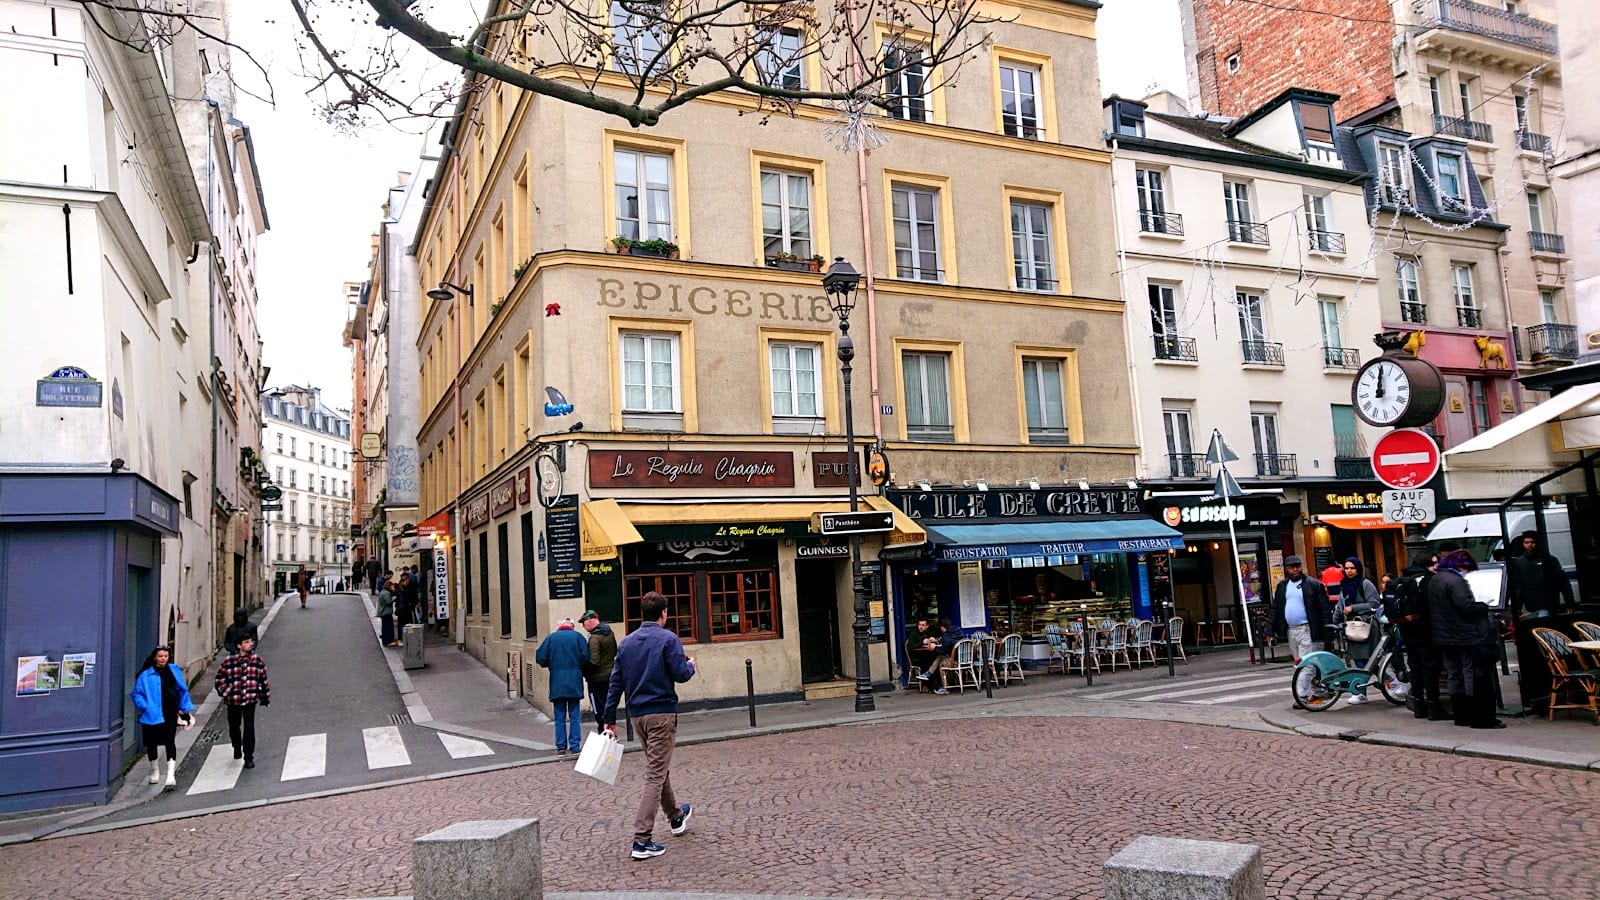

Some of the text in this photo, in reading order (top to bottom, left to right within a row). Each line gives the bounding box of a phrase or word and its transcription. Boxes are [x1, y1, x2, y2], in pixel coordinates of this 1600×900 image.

[596, 278, 834, 323] EPICERIE
[882, 406, 892, 415] 10
[612, 454, 776, 483] Le Requin Chagrin
[817, 462, 859, 476] PUB
[1391, 491, 1425, 501] SAUF
[999, 491, 1038, 516] DE
[1046, 490, 1141, 515] CRETE
[715, 525, 785, 537] Le Requin Chagrin
[1040, 543, 1085, 555] TRAITEUR
[1118, 538, 1172, 550] RESTAURANT
[798, 545, 849, 556] GUINNESS
[943, 546, 1008, 559] DEGUSTATION
[436, 550, 448, 619] SANDWICHERIE
